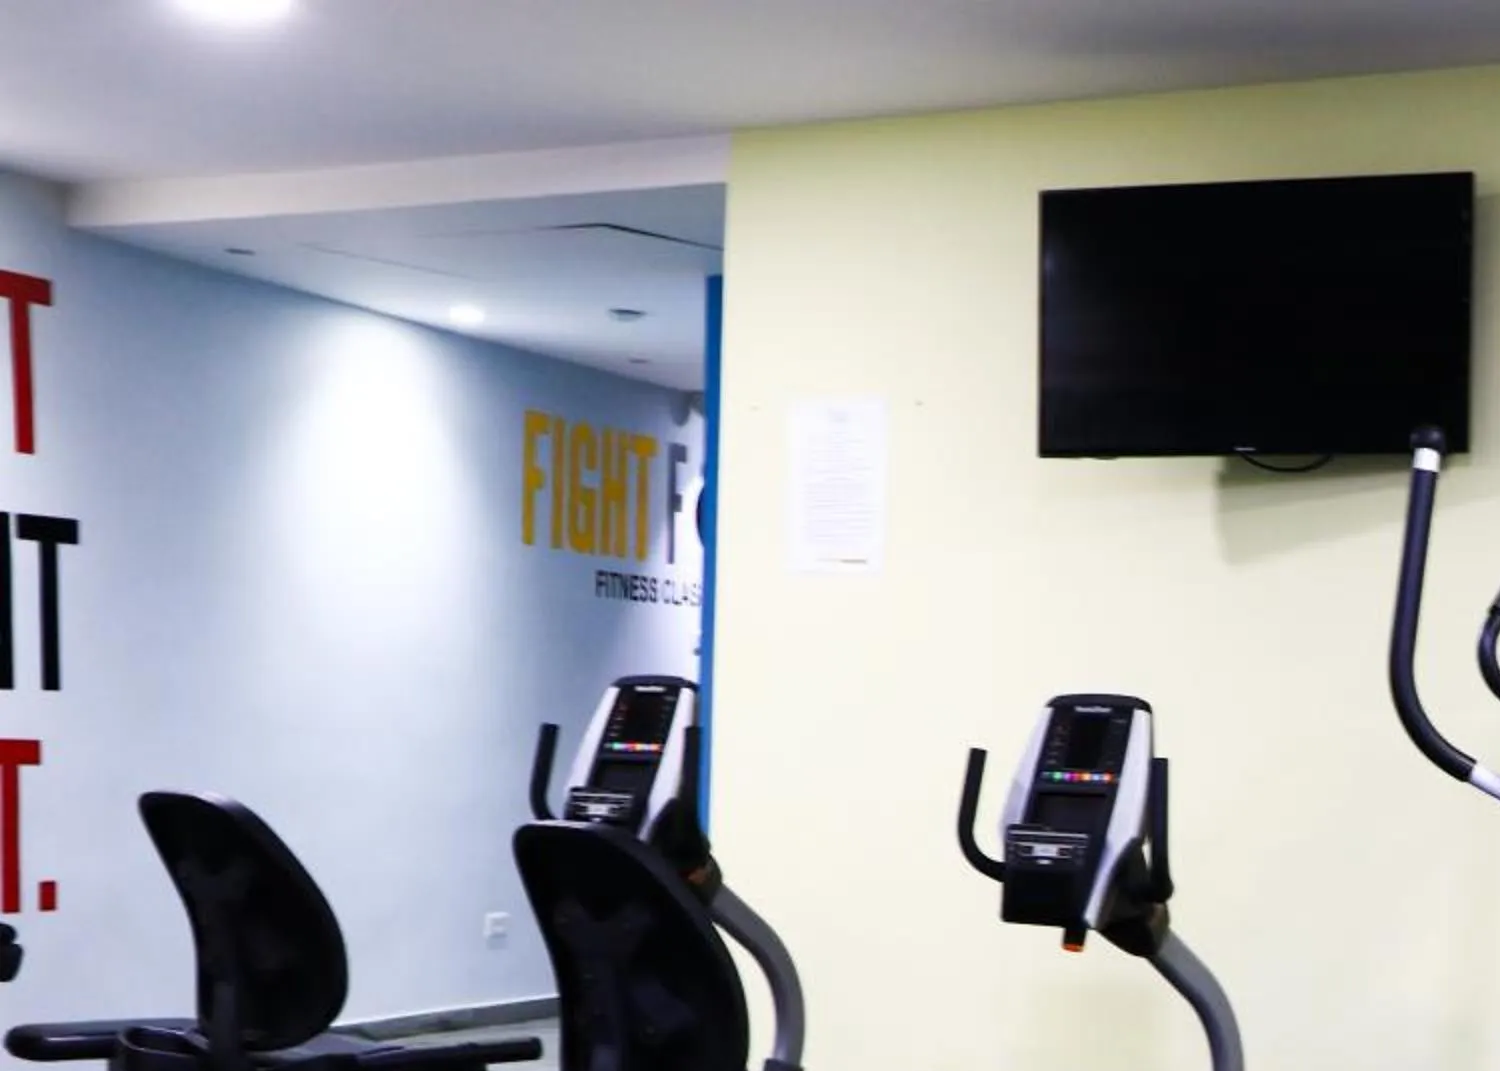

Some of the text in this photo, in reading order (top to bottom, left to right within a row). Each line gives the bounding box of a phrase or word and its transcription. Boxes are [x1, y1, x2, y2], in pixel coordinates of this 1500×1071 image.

[522, 410, 659, 562] FIGHT
[666, 442, 705, 564] F
[595, 569, 658, 604] FITNESS
